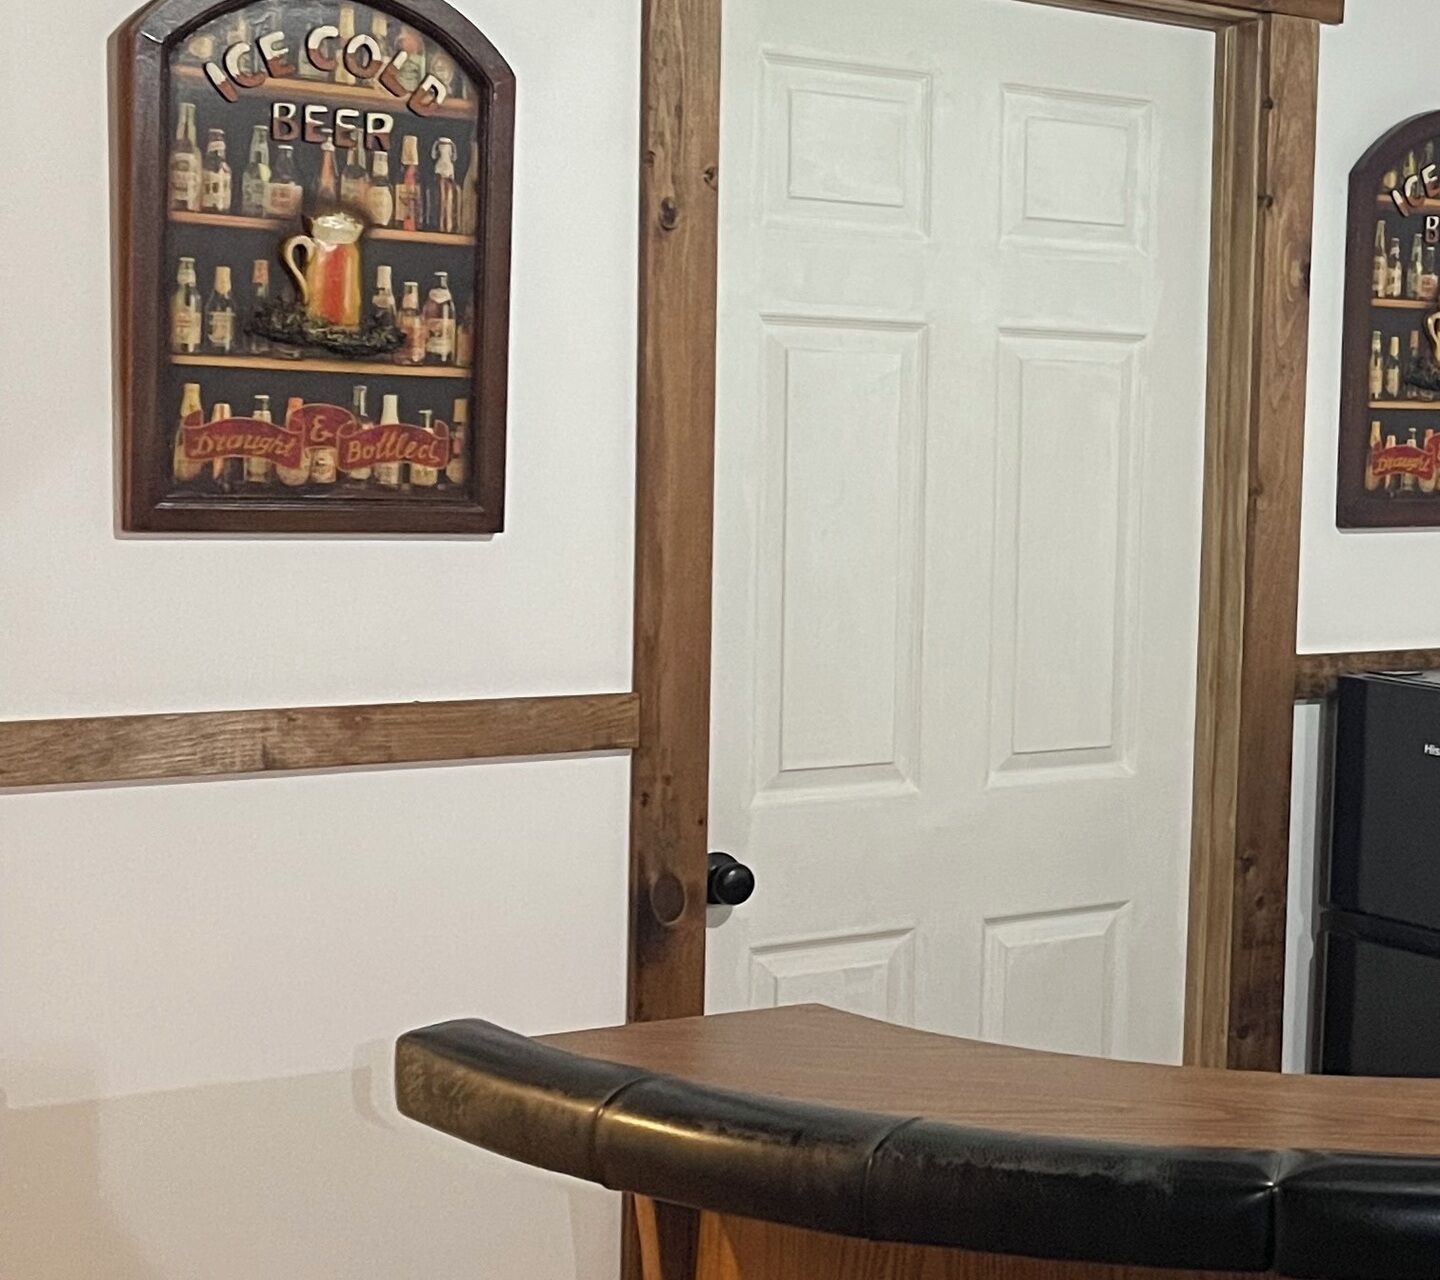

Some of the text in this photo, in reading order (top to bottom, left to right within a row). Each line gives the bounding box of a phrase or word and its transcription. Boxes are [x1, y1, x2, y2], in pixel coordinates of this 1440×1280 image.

[204, 25, 447, 117] ICE COLD
[271, 102, 394, 151] BEER
[1391, 164, 1440, 217] ICE
[310, 415, 333, 442] &
[346, 430, 440, 463] Bottled
